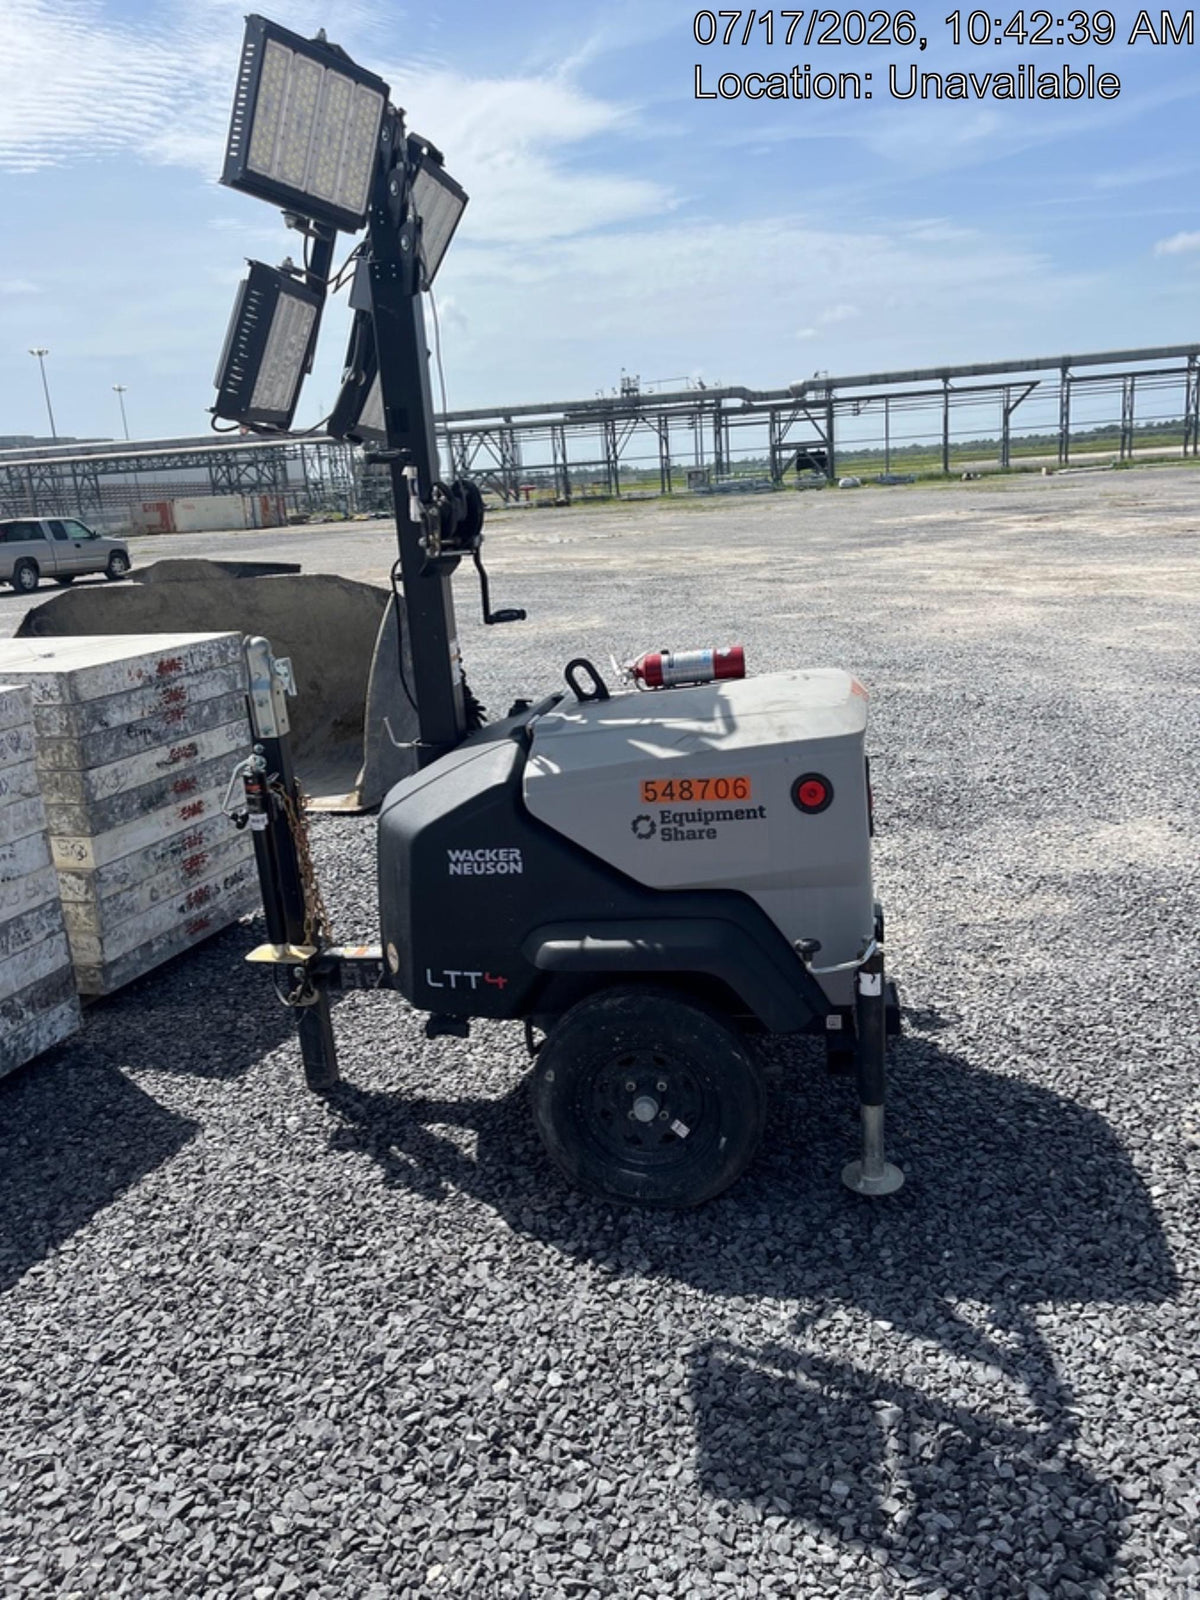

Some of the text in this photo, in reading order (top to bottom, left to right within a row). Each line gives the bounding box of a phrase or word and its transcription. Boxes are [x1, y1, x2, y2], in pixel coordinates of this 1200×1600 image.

[644, 777, 748, 803] 548706
[659, 804, 767, 827] Equipment
[660, 827, 718, 842] Share
[447, 848, 522, 862] WACKER
[448, 862, 524, 876] NEUSON
[425, 968, 508, 990] LTT4
